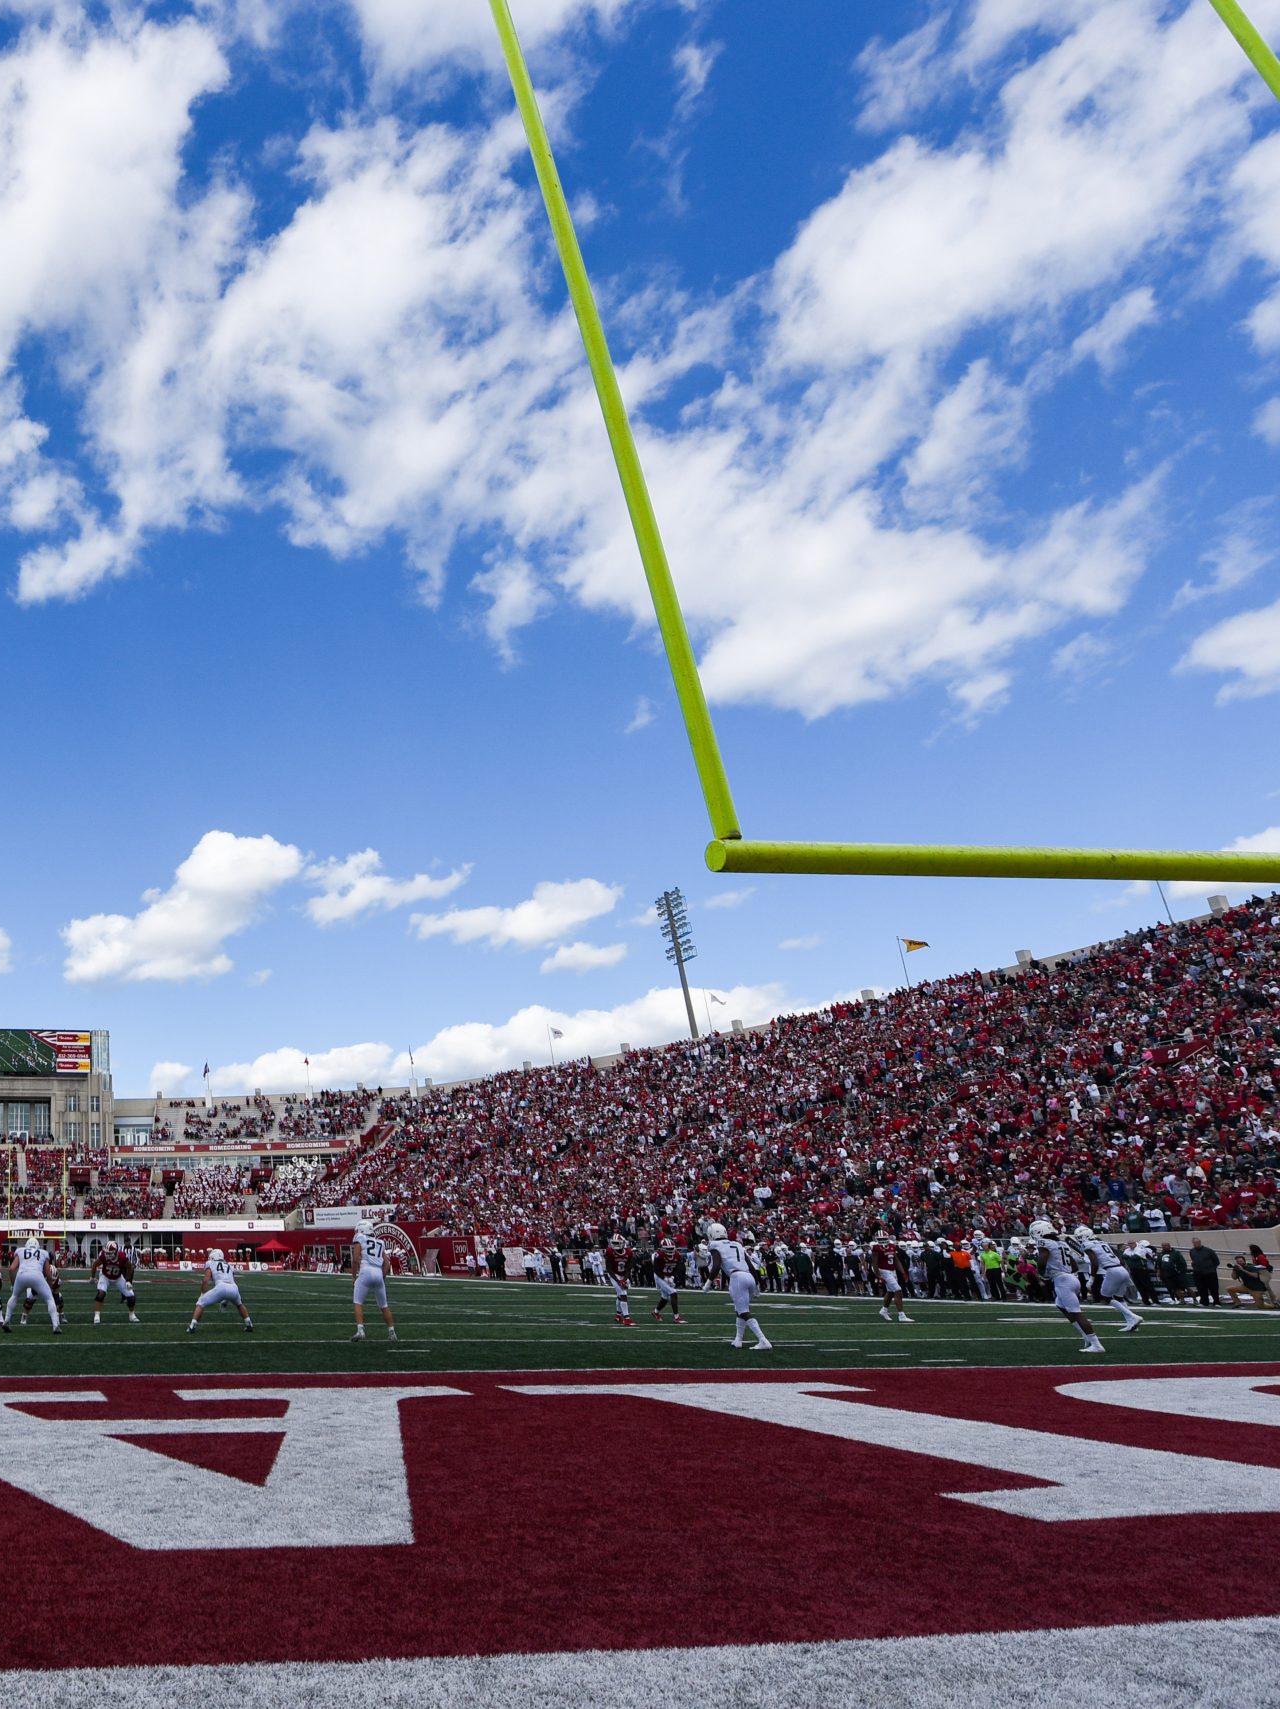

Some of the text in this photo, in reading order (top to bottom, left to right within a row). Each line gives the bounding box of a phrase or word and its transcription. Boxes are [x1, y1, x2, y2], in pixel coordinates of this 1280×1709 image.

[1167, 1048, 1180, 1059] 27
[969, 1085, 979, 1093] 26
[286, 1141, 330, 1149] HOMECOMING
[23, 1249, 40, 1260] 64
[366, 1240, 384, 1258] 27
[455, 1244, 467, 1254] 200
[729, 1245, 741, 1262] 7
[1101, 1244, 1116, 1259] 9
[1058, 1247, 1071, 1266] 15
[216, 1262, 231, 1274] 47
